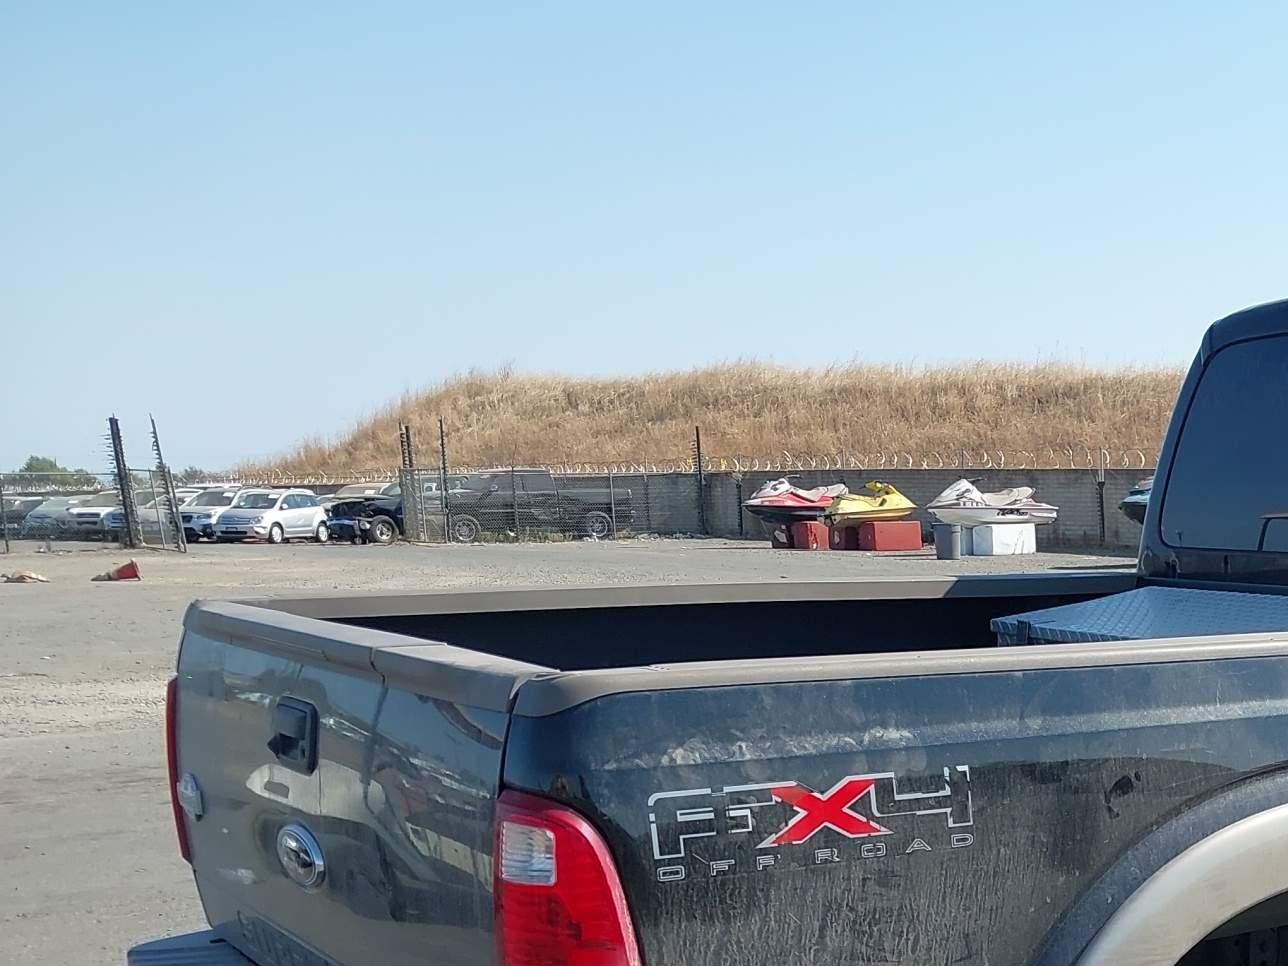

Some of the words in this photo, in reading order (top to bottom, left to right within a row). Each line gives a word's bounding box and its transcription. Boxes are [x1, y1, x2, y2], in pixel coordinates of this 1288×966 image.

[647, 764, 974, 860] FX4
[656, 853, 782, 882] OFF
[815, 832, 975, 864] ROAD
